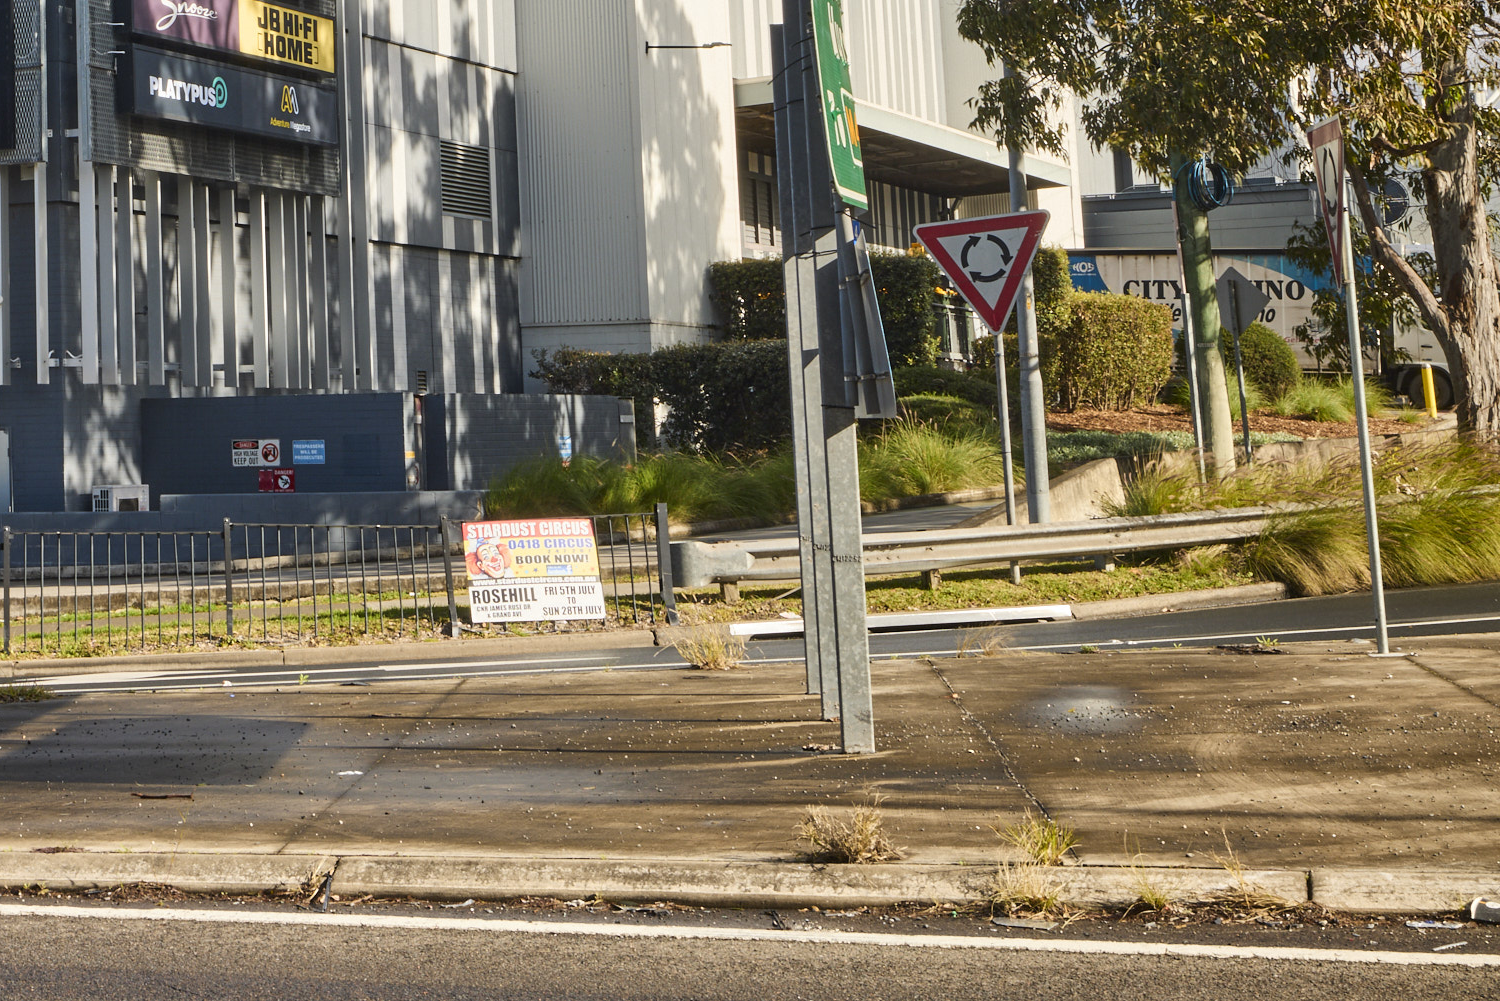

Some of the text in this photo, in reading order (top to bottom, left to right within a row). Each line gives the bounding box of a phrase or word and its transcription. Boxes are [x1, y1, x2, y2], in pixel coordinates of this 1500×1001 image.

[257, 6, 280, 33] JB
[149, 76, 216, 107] PLATYPUS
[1123, 280, 1182, 300] CITY
[234, 457, 259, 465] KEEP OUT
[467, 521, 589, 538] STARDUST CIRCUS
[508, 538, 593, 549] 0418 CIRCUS
[516, 554, 589, 564] BOOK NOW!
[472, 576, 597, 586] www.stardustcircus.com.au
[472, 587, 538, 604] ROSEHILL
[544, 585, 595, 595] FRI 5TH JULY
[543, 605, 602, 616] SUN 28TH JULY
